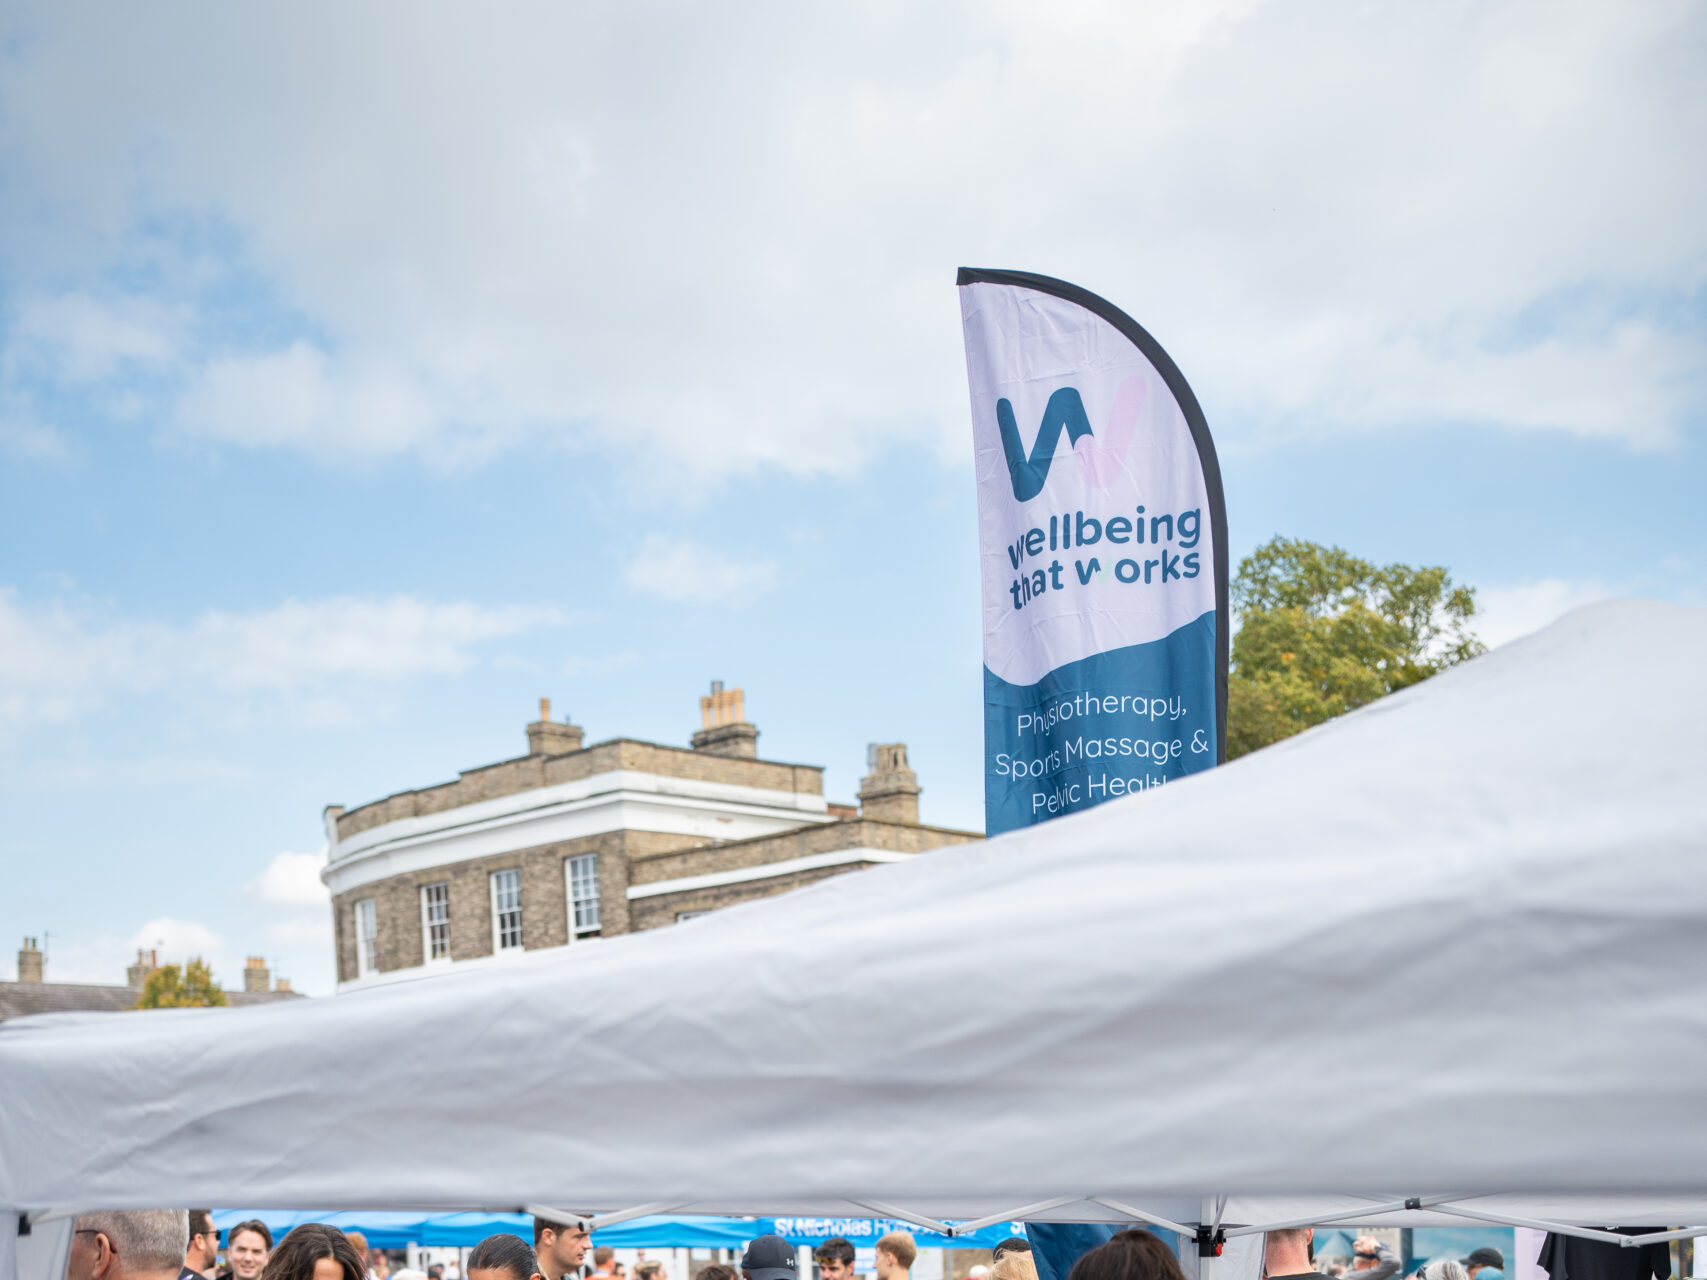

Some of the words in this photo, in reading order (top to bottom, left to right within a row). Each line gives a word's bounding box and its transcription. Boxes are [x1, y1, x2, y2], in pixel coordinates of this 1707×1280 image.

[1008, 504, 1201, 570] wellbeing
[1010, 559, 1064, 610] that
[1075, 549, 1200, 585] works
[1017, 691, 1187, 737] Physiotherapy,
[995, 749, 1061, 782] Sports
[1064, 736, 1182, 766] Massage
[1190, 729, 1209, 754] &
[1032, 782, 1081, 815] Pelvic
[795, 1218, 872, 1237] Nicholas
